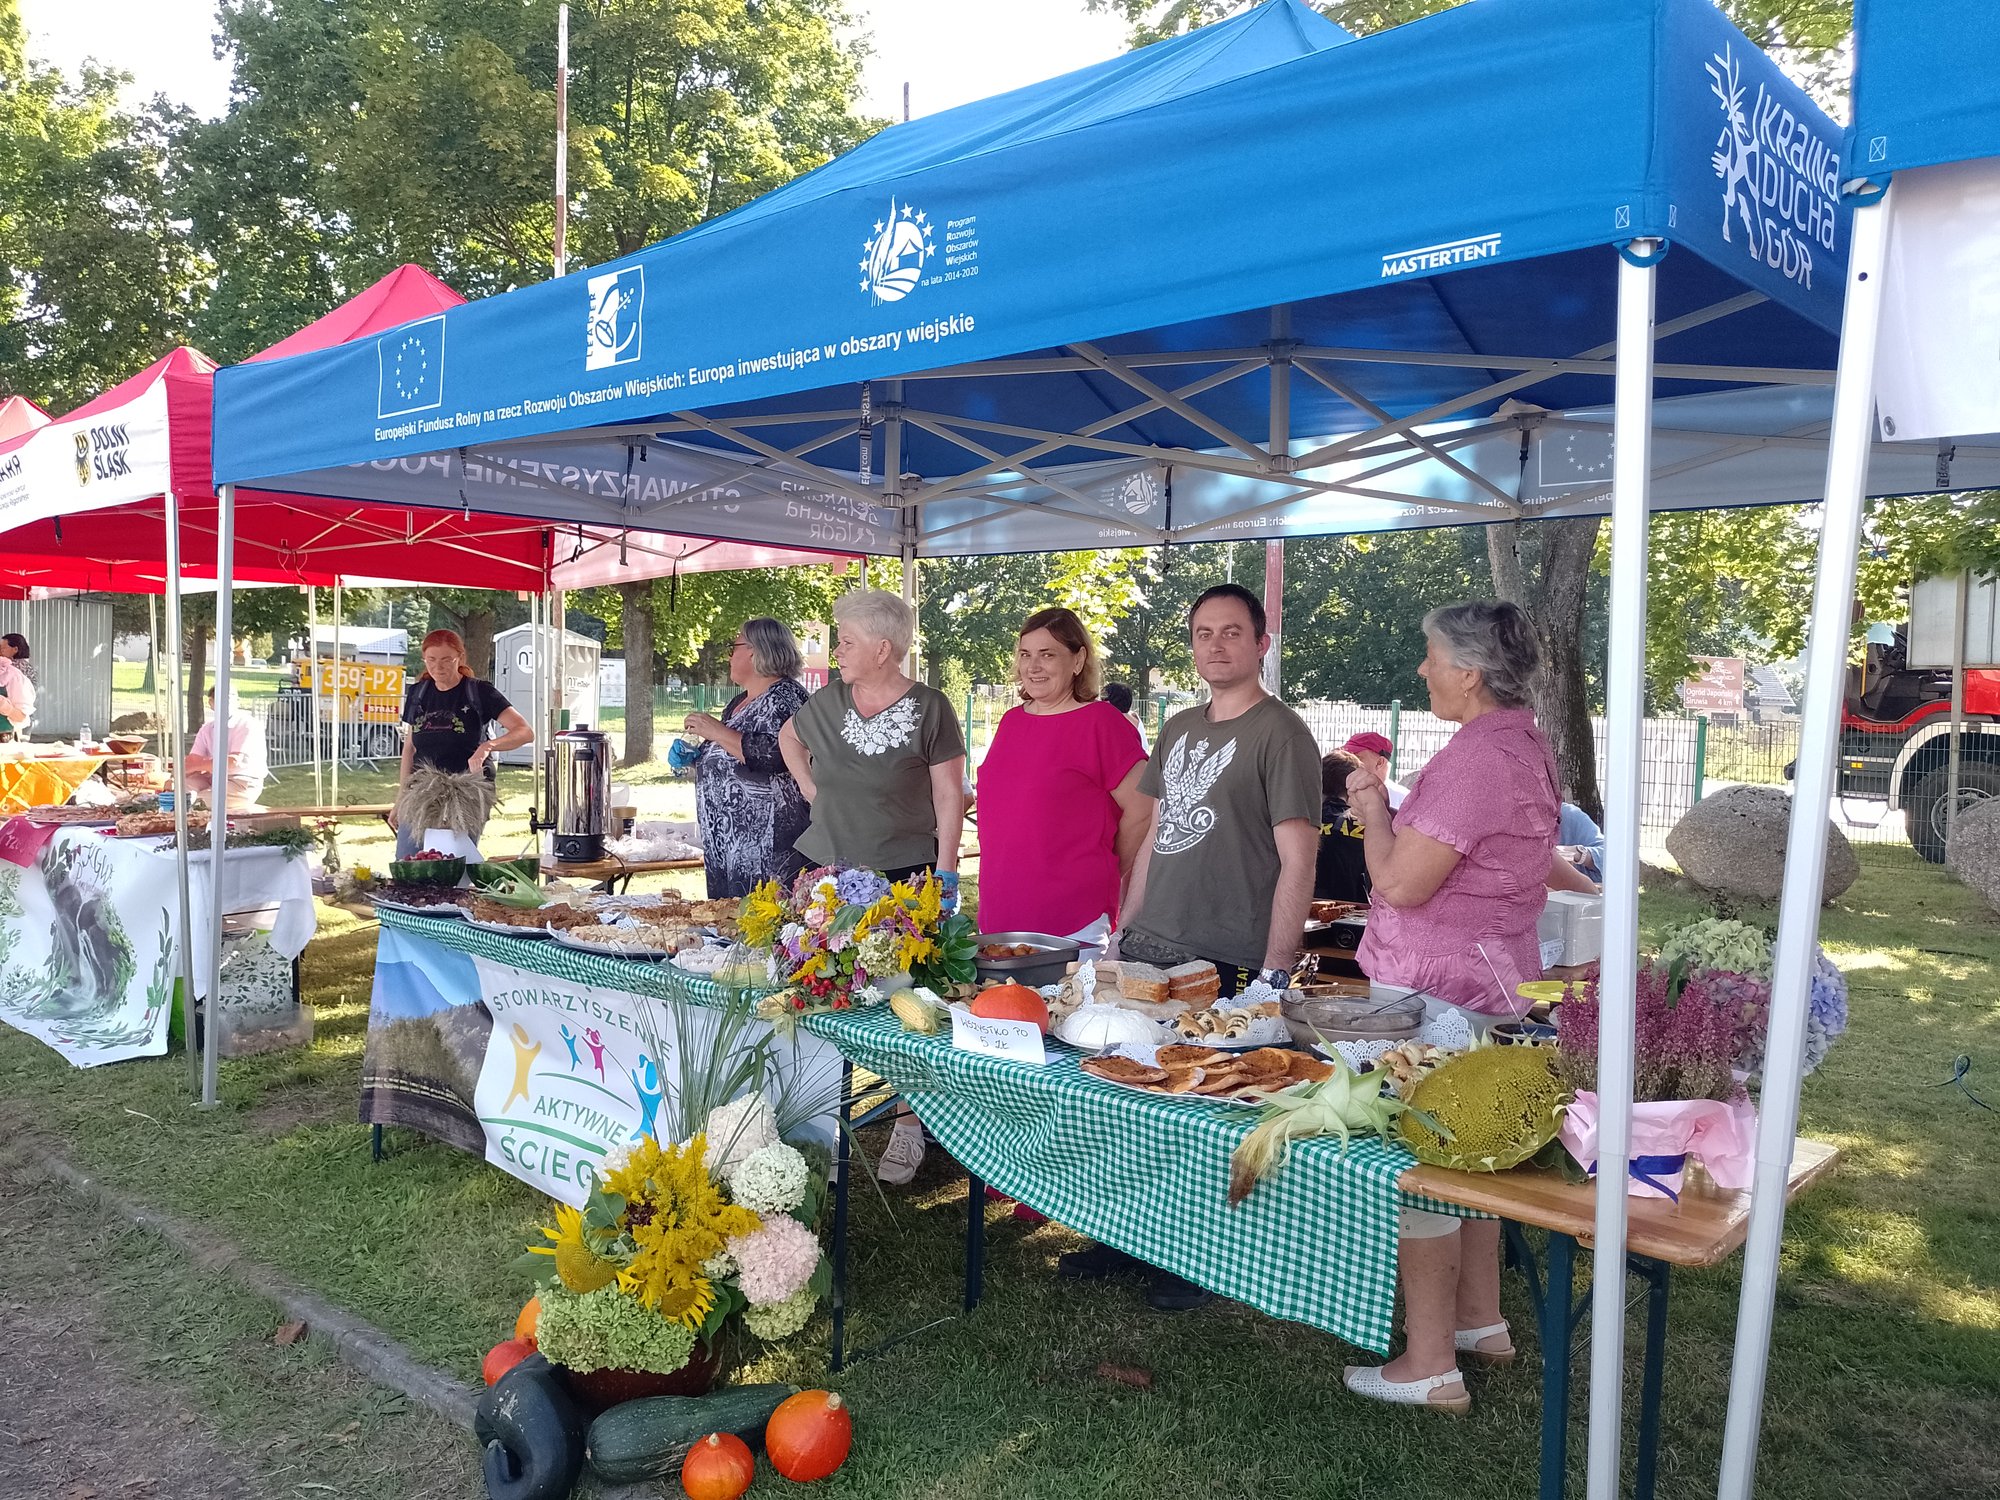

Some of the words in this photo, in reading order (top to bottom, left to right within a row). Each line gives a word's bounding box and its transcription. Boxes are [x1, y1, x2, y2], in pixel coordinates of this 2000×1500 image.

[947, 216, 976, 229] Program
[946, 227, 975, 241] Rozwoju
[945, 239, 979, 254] Obszarów
[1765, 217, 1813, 291] GÓR
[945, 251, 978, 266] Wiejskich
[1381, 239, 1501, 278] MASTERTENT
[921, 279, 930, 287] na
[930, 275, 943, 285] lata
[944, 266, 979, 282] 2014-2020
[586, 292, 596, 357] LEADER
[375, 424, 417, 441] Europejski
[418, 417, 454, 434] Fundusz
[455, 412, 481, 427] Rolny
[483, 410, 495, 422] na
[497, 405, 522, 420] rzecz
[524, 396, 567, 415] Rozwoju
[568, 385, 622, 407] Obszarów
[625, 372, 686, 397] Wiejskich:
[688, 365, 735, 385] Europa
[738, 347, 820, 376] inwestująca
[824, 344, 837, 359] w
[840, 330, 902, 356] obszary
[906, 312, 975, 343] wiejskie
[90, 421, 131, 452] DOLNY
[93, 449, 132, 481] ŚLĄSK
[1685, 687, 1706, 697] Ogród
[1706, 688, 1733, 698] Japoński
[1685, 696, 1708, 705] Siruwia
[493, 988, 673, 1060] STOWARZYSZENIE
[960, 1017, 1009, 1036] WSZYSTKO
[1012, 1026, 1029, 1037] PO
[979, 1035, 989, 1048] 5
[533, 1095, 628, 1146] AKTYWNE
